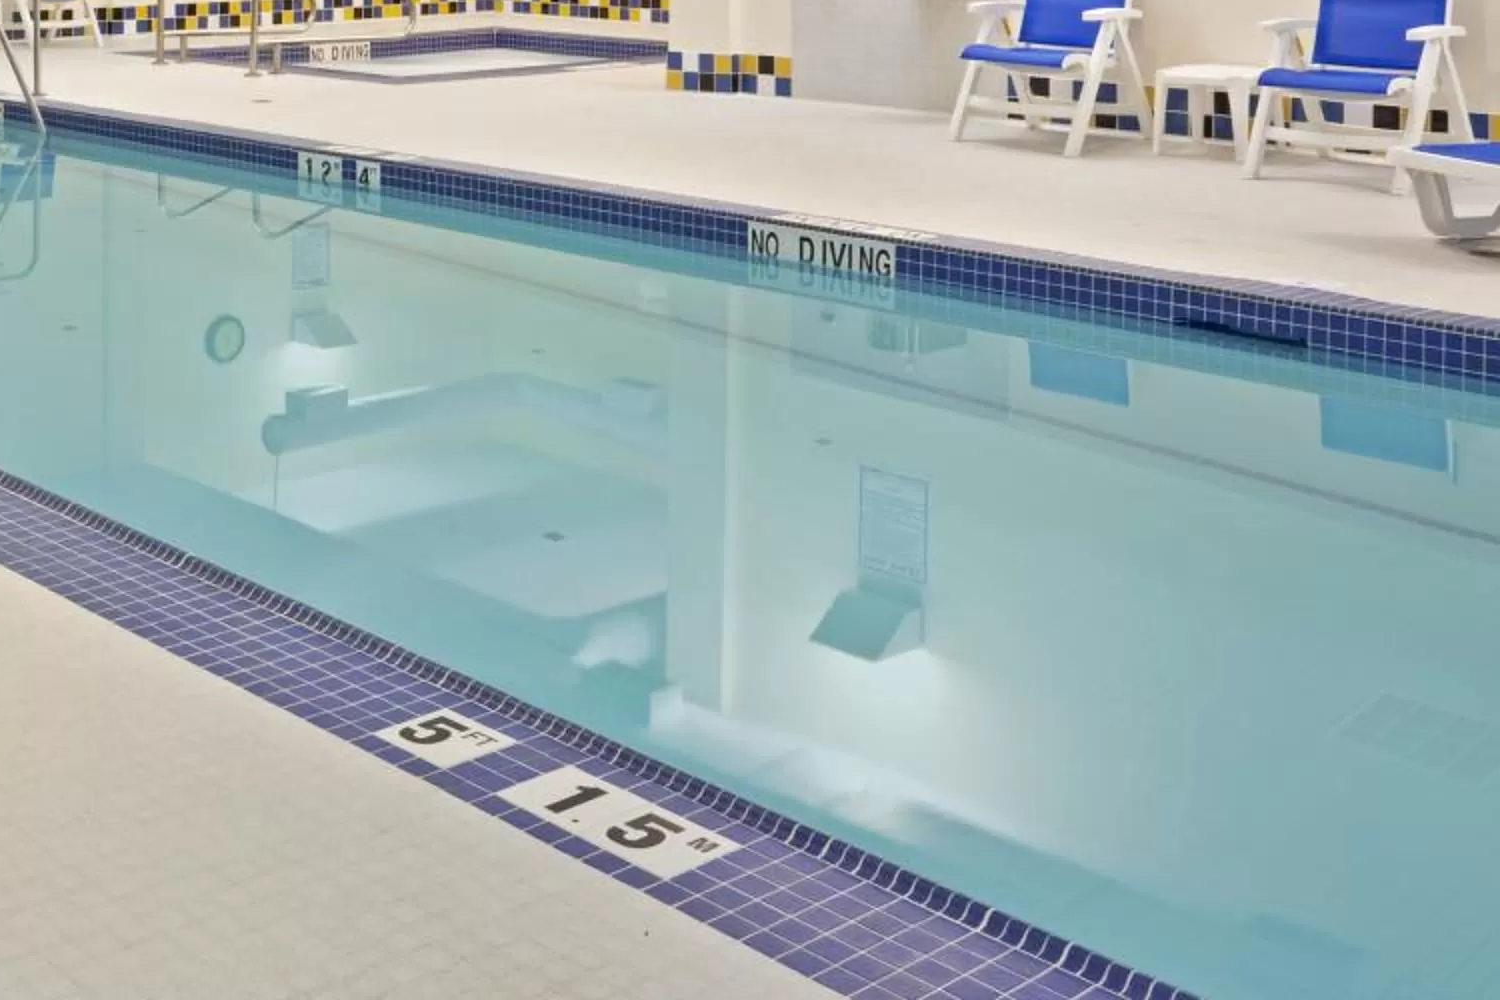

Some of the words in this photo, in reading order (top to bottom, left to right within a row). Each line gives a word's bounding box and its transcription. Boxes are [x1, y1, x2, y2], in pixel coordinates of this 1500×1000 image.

[311, 46, 325, 61] NO
[330, 43, 369, 61] DIVING
[750, 227, 780, 258] NO
[798, 236, 892, 277] DIVING
[460, 729, 500, 748] FT
[685, 835, 720, 854] M
